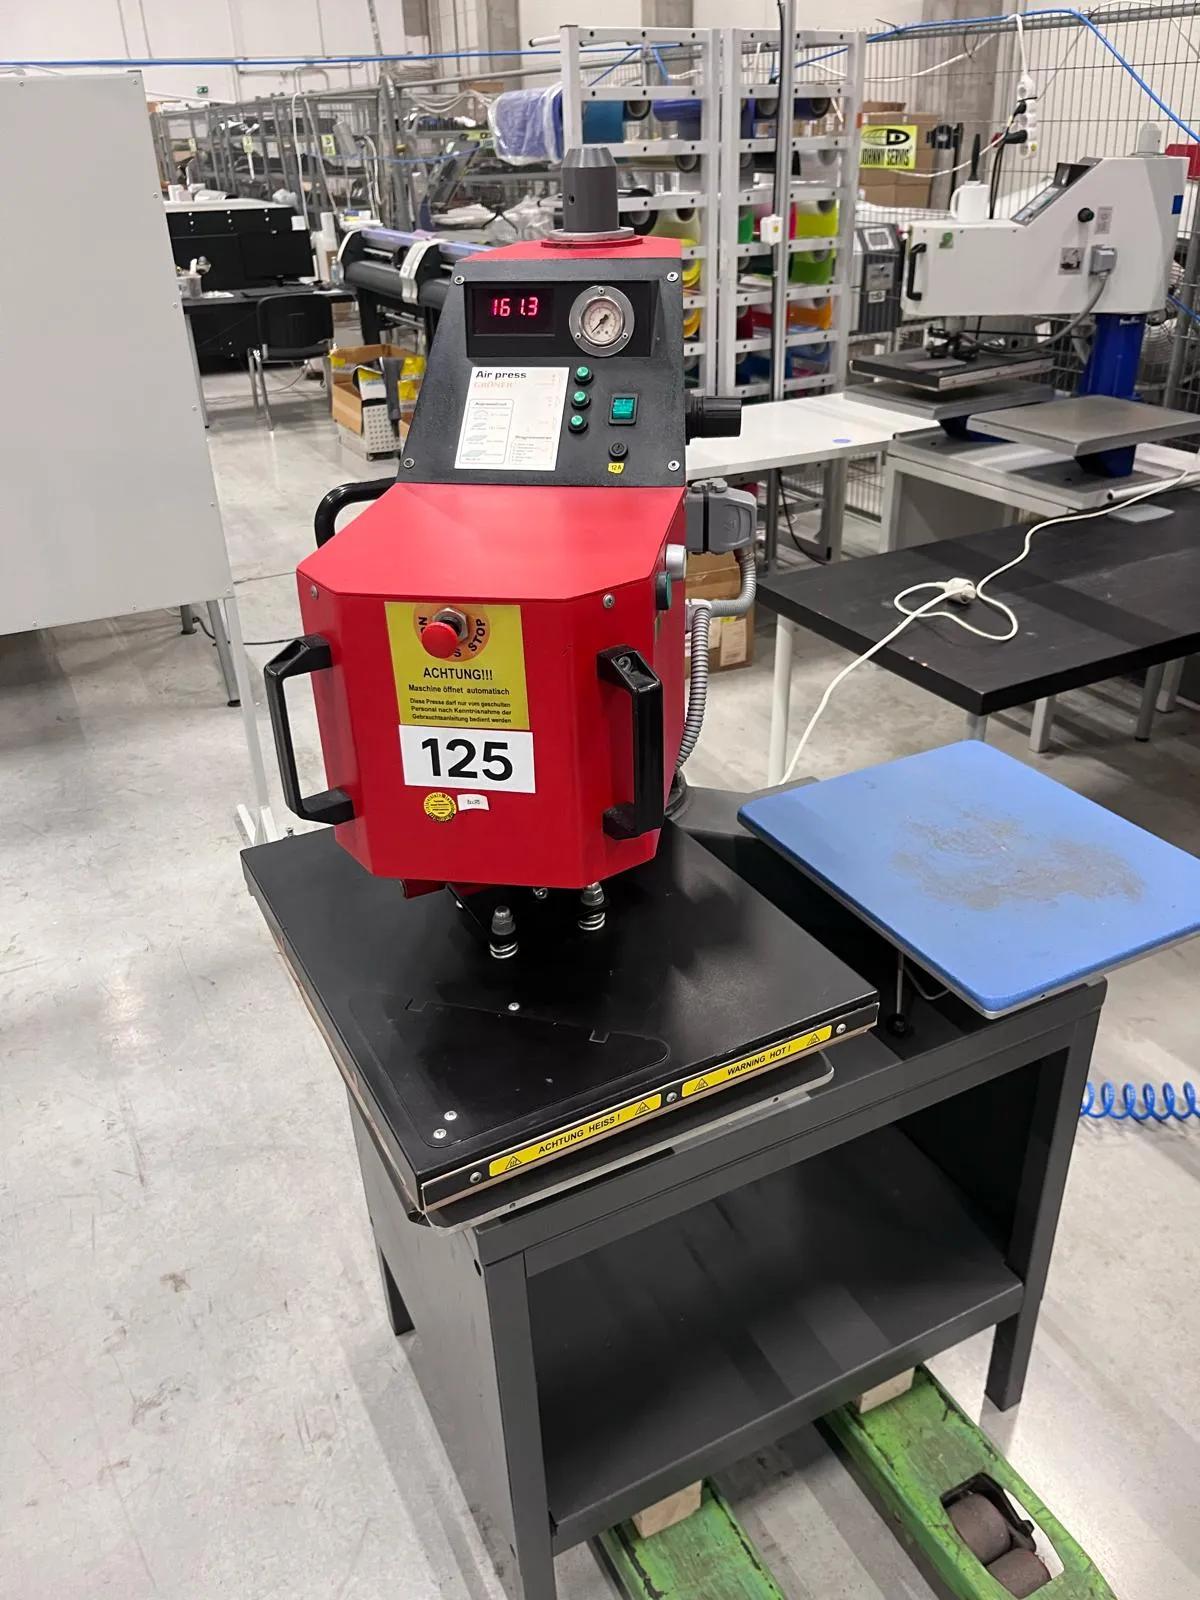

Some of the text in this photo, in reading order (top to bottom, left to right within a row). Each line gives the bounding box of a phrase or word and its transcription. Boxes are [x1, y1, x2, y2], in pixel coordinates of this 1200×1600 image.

[475, 370, 527, 381] Air press
[468, 618, 486, 651] STOP
[423, 667, 493, 681] ACHTUNG!!!
[408, 684, 510, 695] Maschine öffnet automatisch
[490, 716, 512, 724] werden
[421, 737, 513, 782] 125
[727, 1055, 766, 1076] WARNING
[769, 1047, 786, 1059] HOT
[538, 1129, 584, 1154] ACHTUNG
[588, 1116, 615, 1134] HEISS
